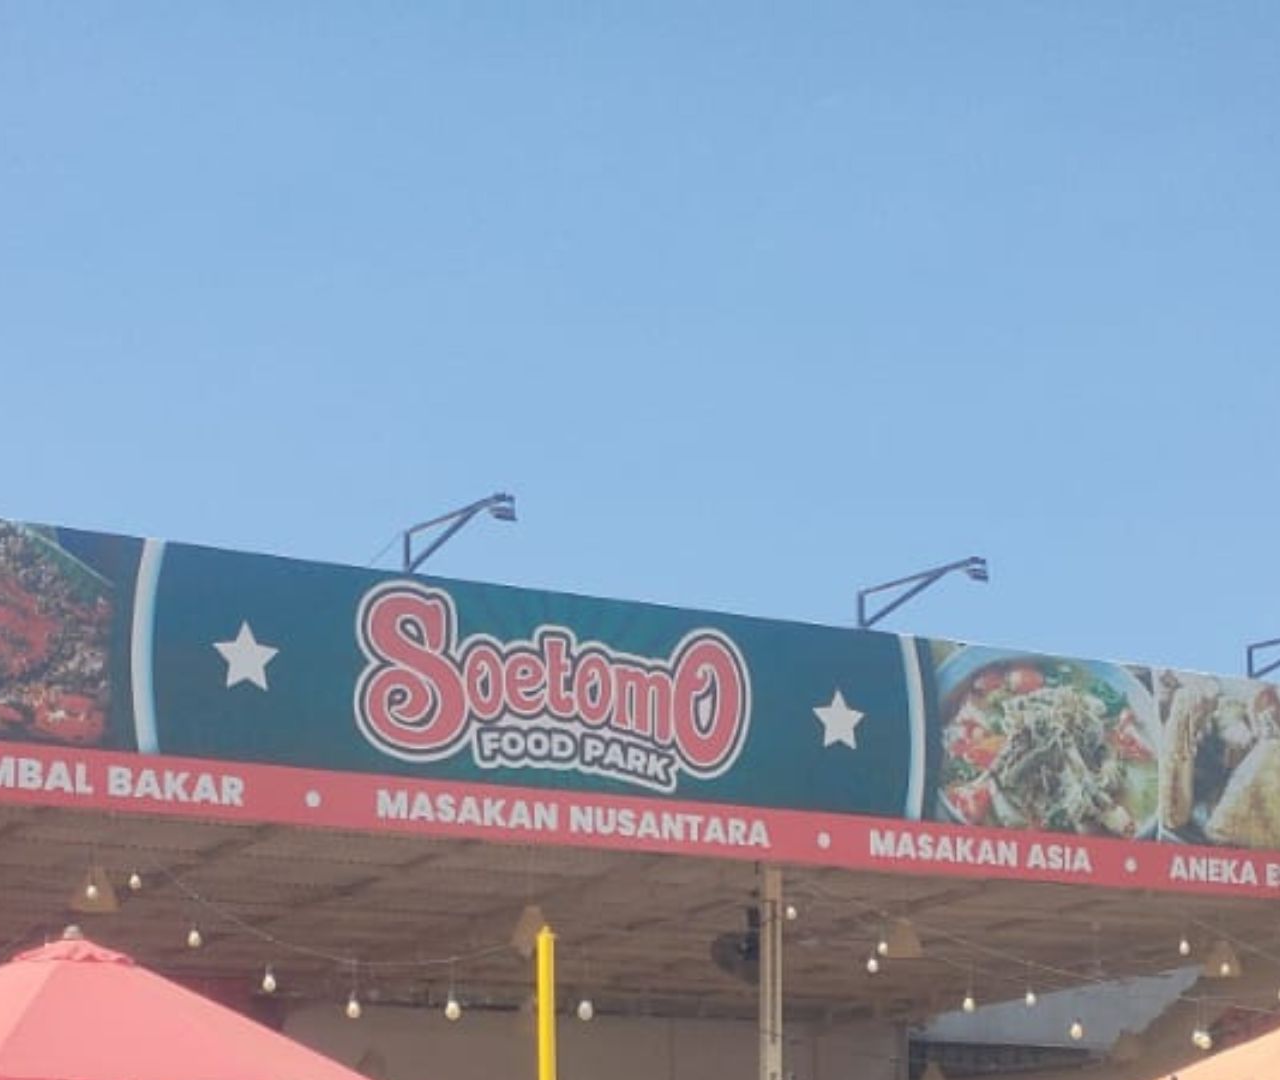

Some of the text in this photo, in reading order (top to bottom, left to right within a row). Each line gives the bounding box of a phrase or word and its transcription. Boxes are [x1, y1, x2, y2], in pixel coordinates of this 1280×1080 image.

[480, 729, 673, 783] FOOD PARK
[107, 765, 246, 807] BAKAR
[375, 789, 770, 848] MASAKAN NUSANTARA
[869, 829, 1092, 873] MASAKAN ASIA
[1169, 855, 1258, 886] ANEKA
